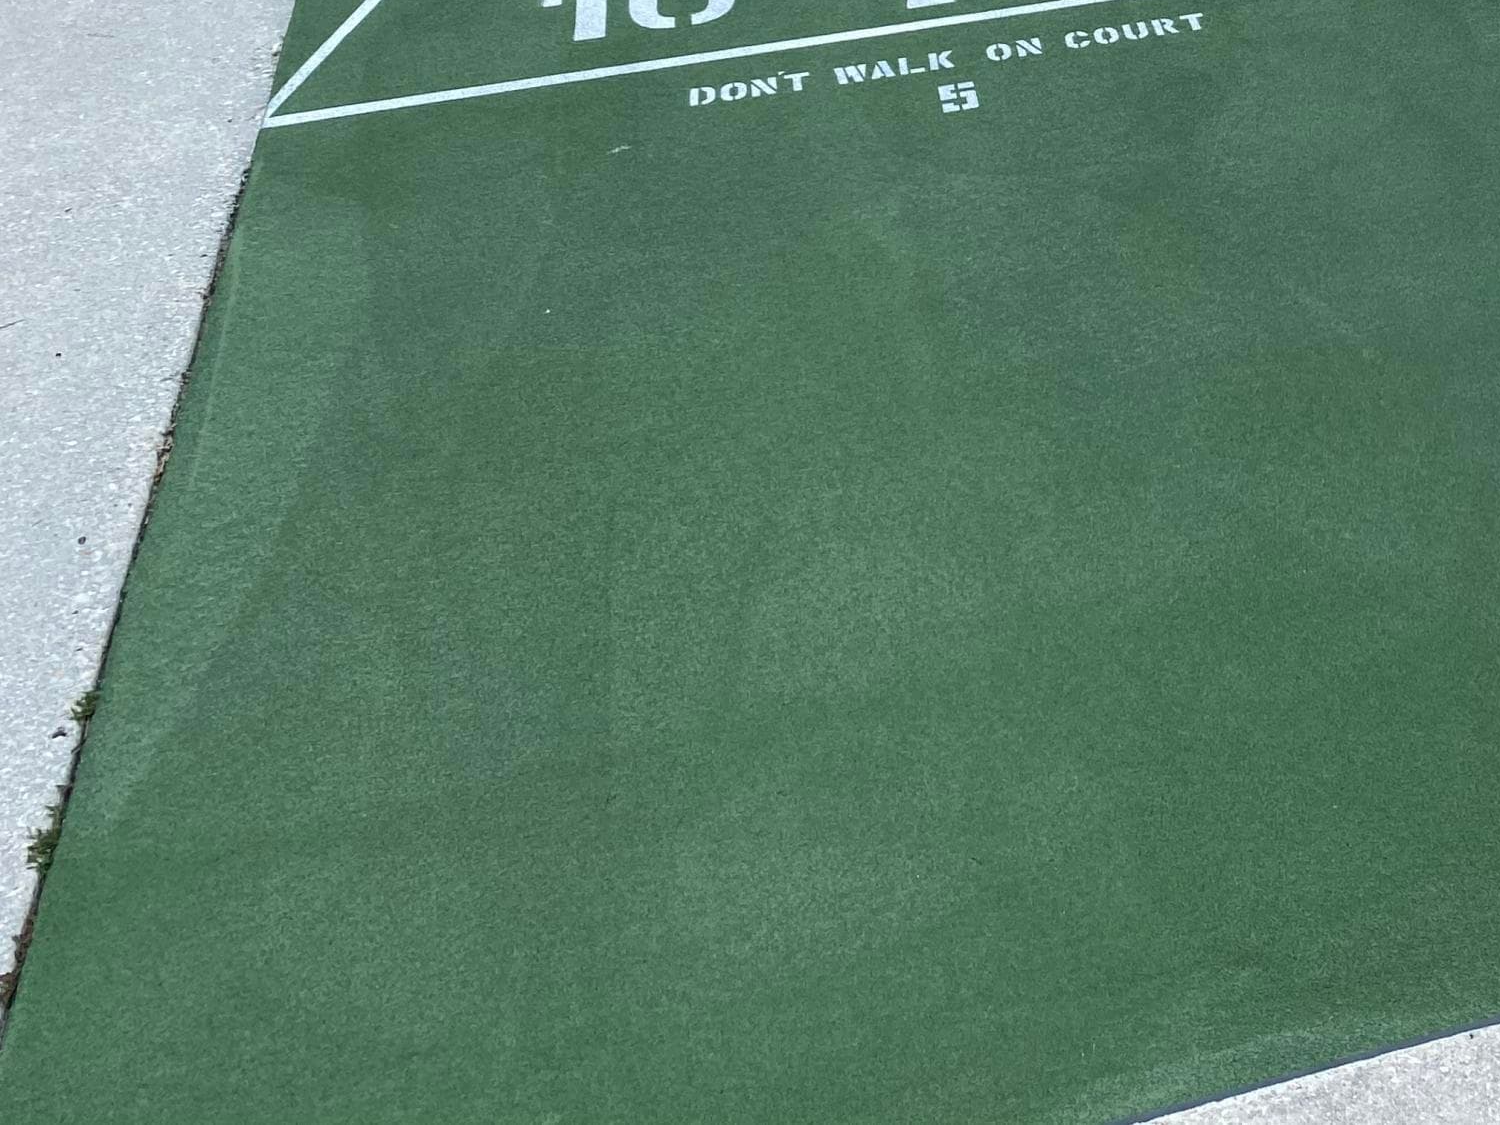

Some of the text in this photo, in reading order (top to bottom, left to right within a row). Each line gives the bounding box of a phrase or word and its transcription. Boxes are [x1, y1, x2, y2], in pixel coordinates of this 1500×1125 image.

[690, 13, 1203, 106] DON'T WALK ON COURT
[938, 82, 979, 113] 5
